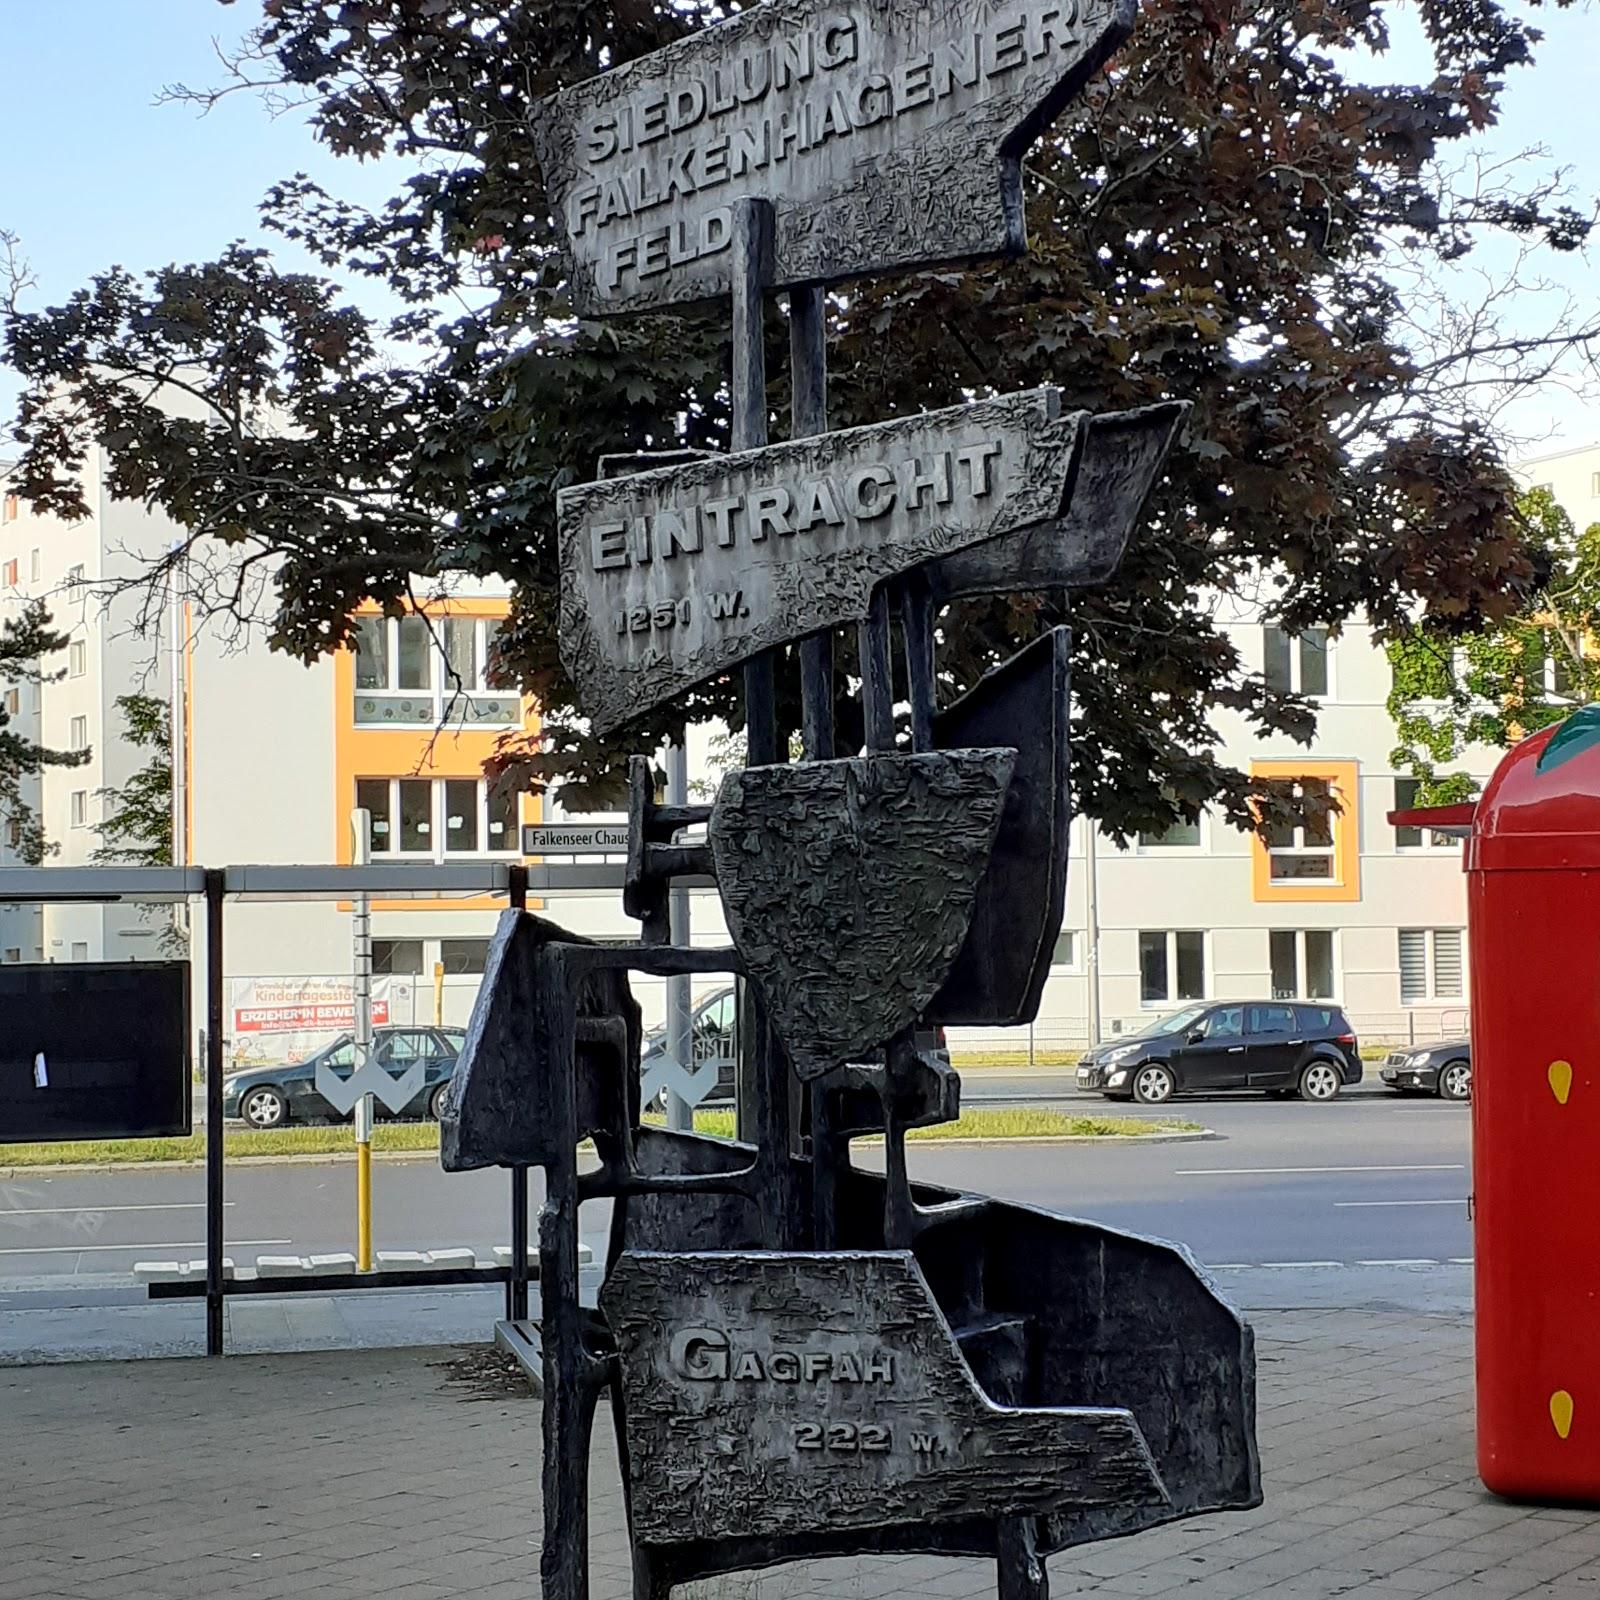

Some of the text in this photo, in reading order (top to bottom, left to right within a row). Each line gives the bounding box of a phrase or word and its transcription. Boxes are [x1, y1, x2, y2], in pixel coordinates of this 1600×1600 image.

[570, 0, 1081, 235] FALKENHAGENER
[586, 15, 859, 162] SIEDLUNG
[606, 206, 732, 290] FELD
[591, 442, 1000, 572] EINTRACHT
[613, 590, 750, 635] 1251 W.
[532, 830, 629, 846] Falkenseer Chaus
[790, 1421, 892, 1455] 222
